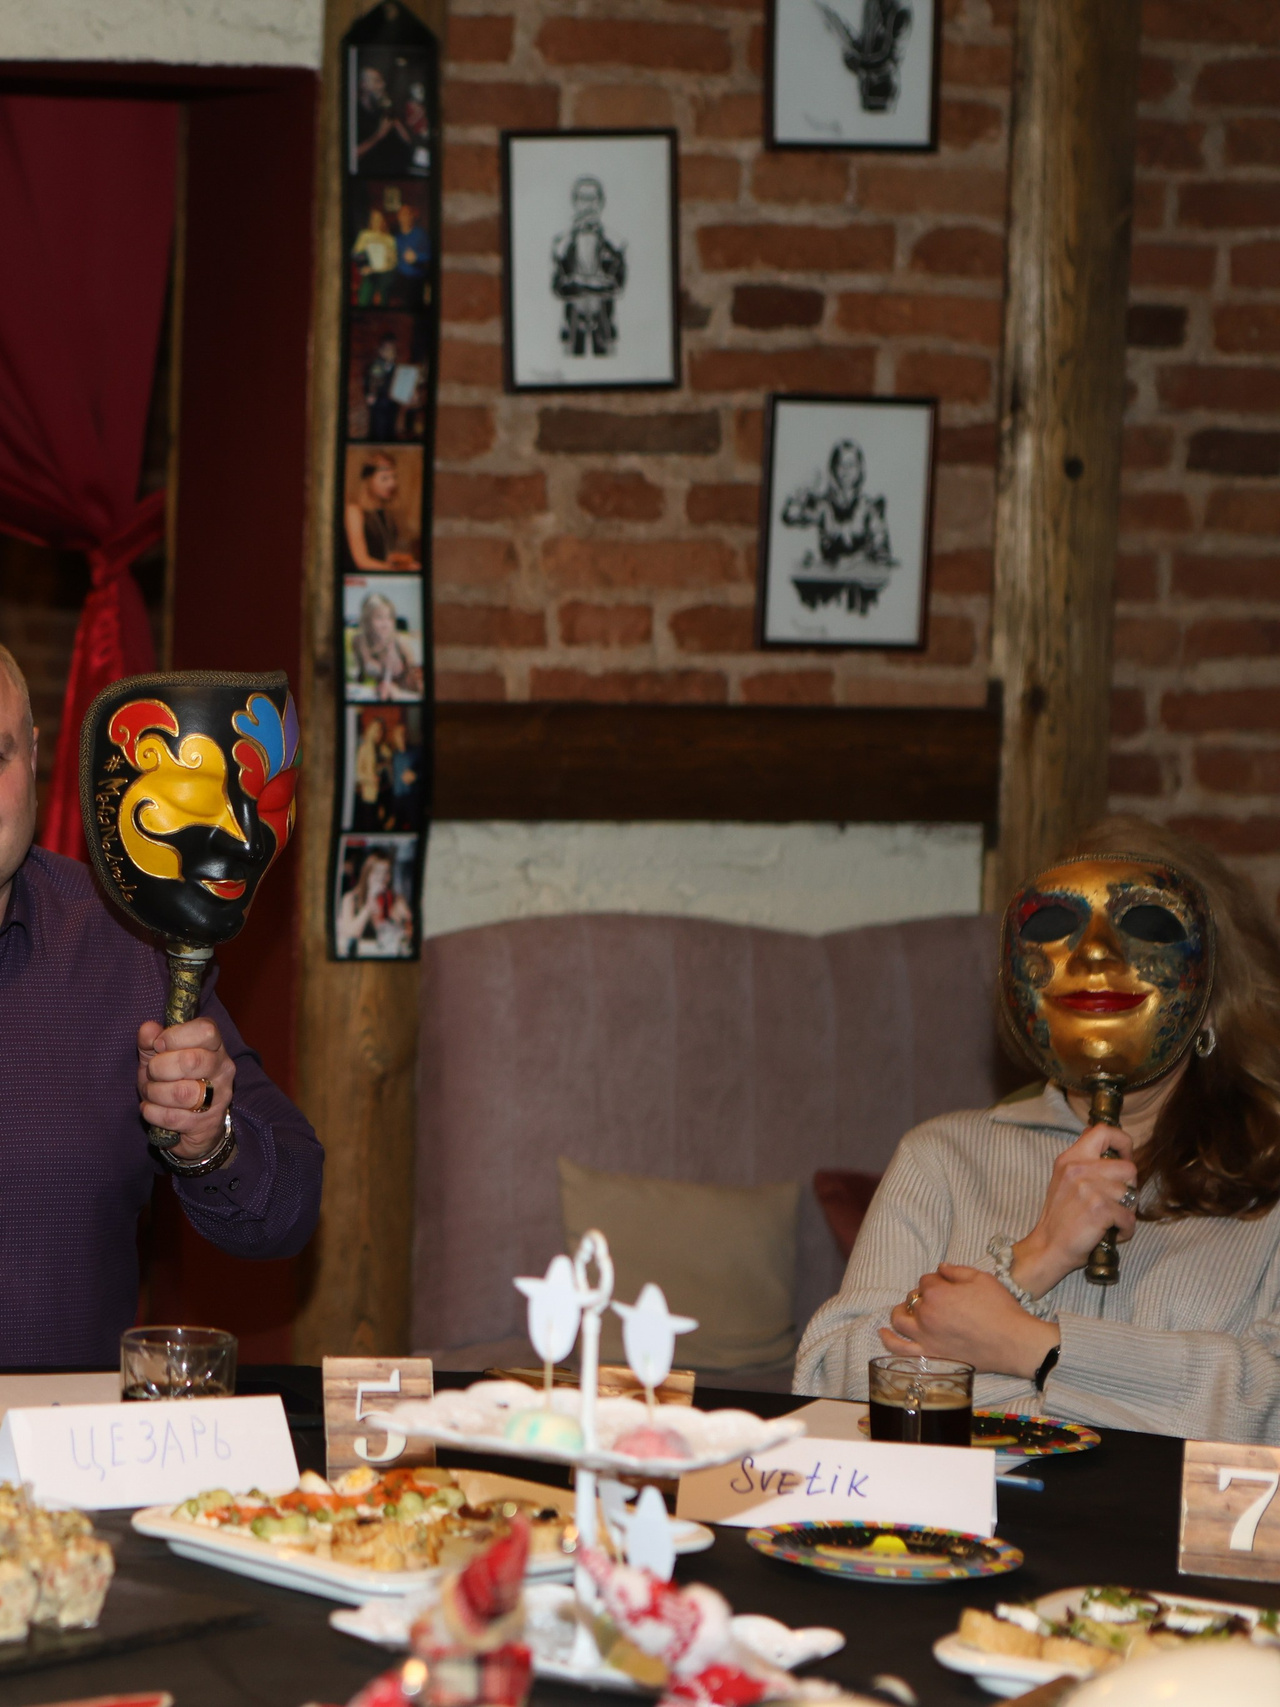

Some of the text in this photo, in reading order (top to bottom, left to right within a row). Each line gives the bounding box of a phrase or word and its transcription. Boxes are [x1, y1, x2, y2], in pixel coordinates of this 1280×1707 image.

[70, 1415, 232, 1481] ЦЕЗАРЬ
[352, 1368, 407, 1463] 5
[1219, 1468, 1280, 1551] 7
